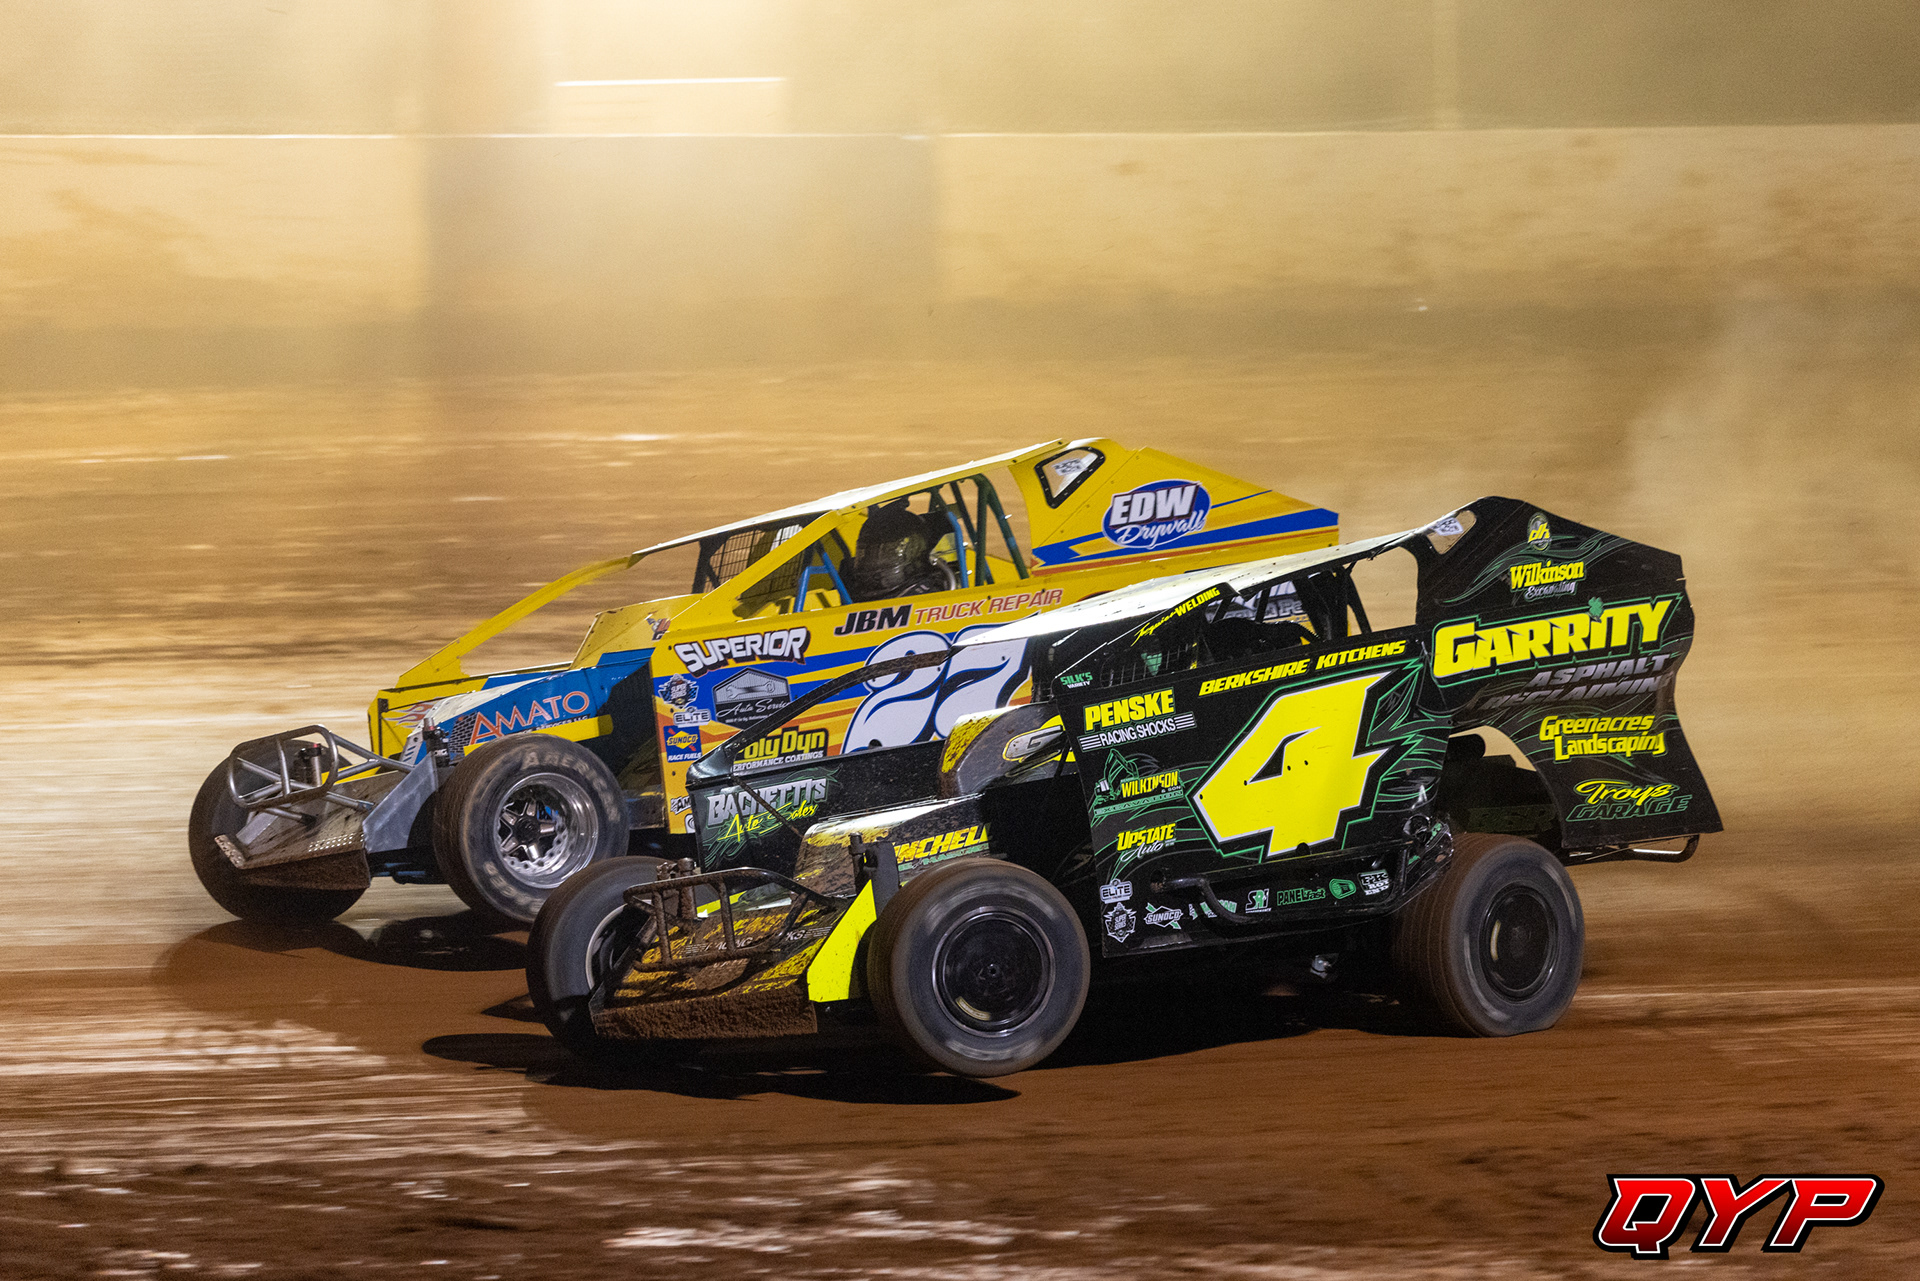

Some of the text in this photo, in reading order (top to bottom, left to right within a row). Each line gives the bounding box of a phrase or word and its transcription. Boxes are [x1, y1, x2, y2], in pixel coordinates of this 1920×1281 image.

[1109, 484, 1198, 529] EDW
[1114, 510, 1207, 549] Drywall
[1510, 560, 1585, 590] Wilkinson
[834, 588, 1064, 636] JBM TRUCK REPAIR
[1174, 587, 1220, 617] WELDING
[674, 626, 809, 676] SUPERIOR
[1060, 671, 1094, 686] SILK'S
[1198, 639, 1407, 696] BERKSHIRE KITCHENS
[1523, 654, 1670, 690] ASPHALT
[841, 622, 1036, 757] 27
[470, 690, 590, 742] AMATO
[716, 702, 754, 718] Auto
[1085, 689, 1175, 732] PENSKE
[667, 733, 698, 746] SUNOCO
[1099, 717, 1176, 747] RACING SHOCKS
[1539, 715, 1655, 741] Greenacres
[668, 752, 702, 762] RACE FUELS
[736, 730, 826, 759] olyDyn
[1554, 731, 1666, 761] Landscaping
[733, 750, 824, 772] ERFORMANCE COATINGS
[1193, 670, 1391, 857] 4
[1121, 771, 1178, 798] WILKINSON
[1576, 780, 1673, 806] Troys
[718, 799, 819, 842] Auto Sales
[1566, 795, 1692, 822] GARAGE
[1117, 823, 1176, 851] UPSTATE
[1120, 839, 1165, 862] Auto
[1146, 910, 1182, 924] SUNOCO
